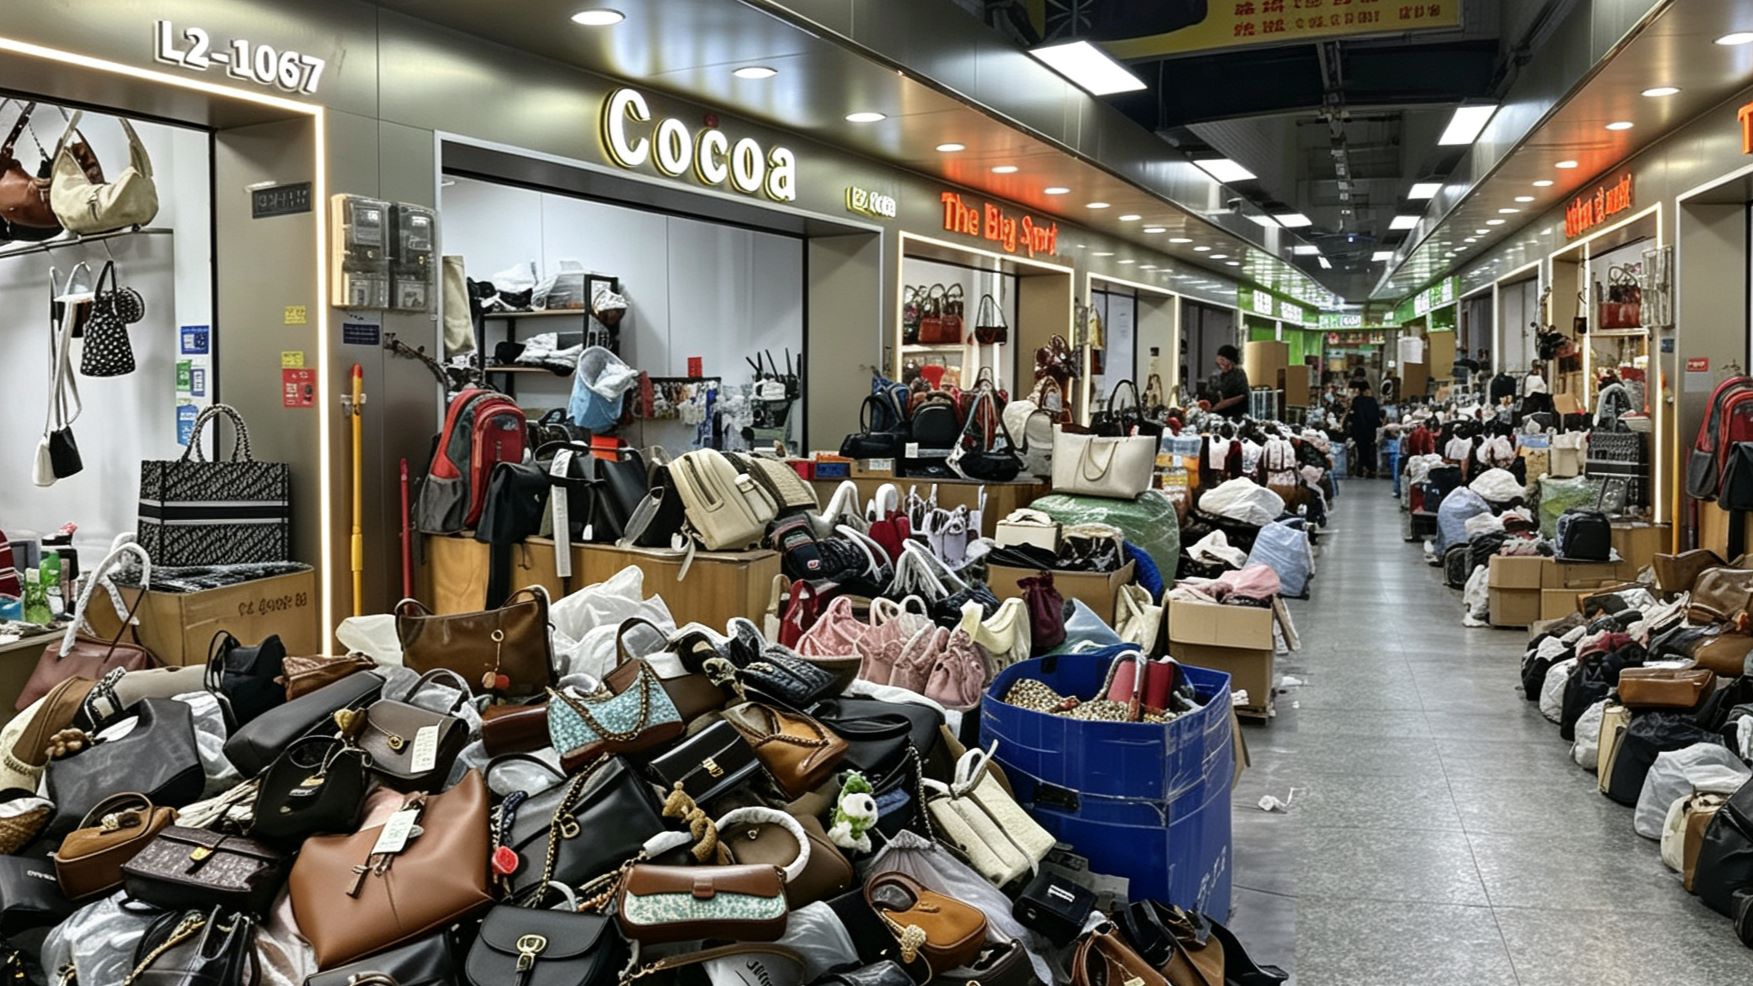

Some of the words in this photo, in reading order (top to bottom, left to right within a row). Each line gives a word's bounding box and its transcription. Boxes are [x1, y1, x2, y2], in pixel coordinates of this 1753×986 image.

[153, 19, 326, 95] L2-1067
[599, 87, 798, 203] Cocoa
[940, 191, 980, 237] The
